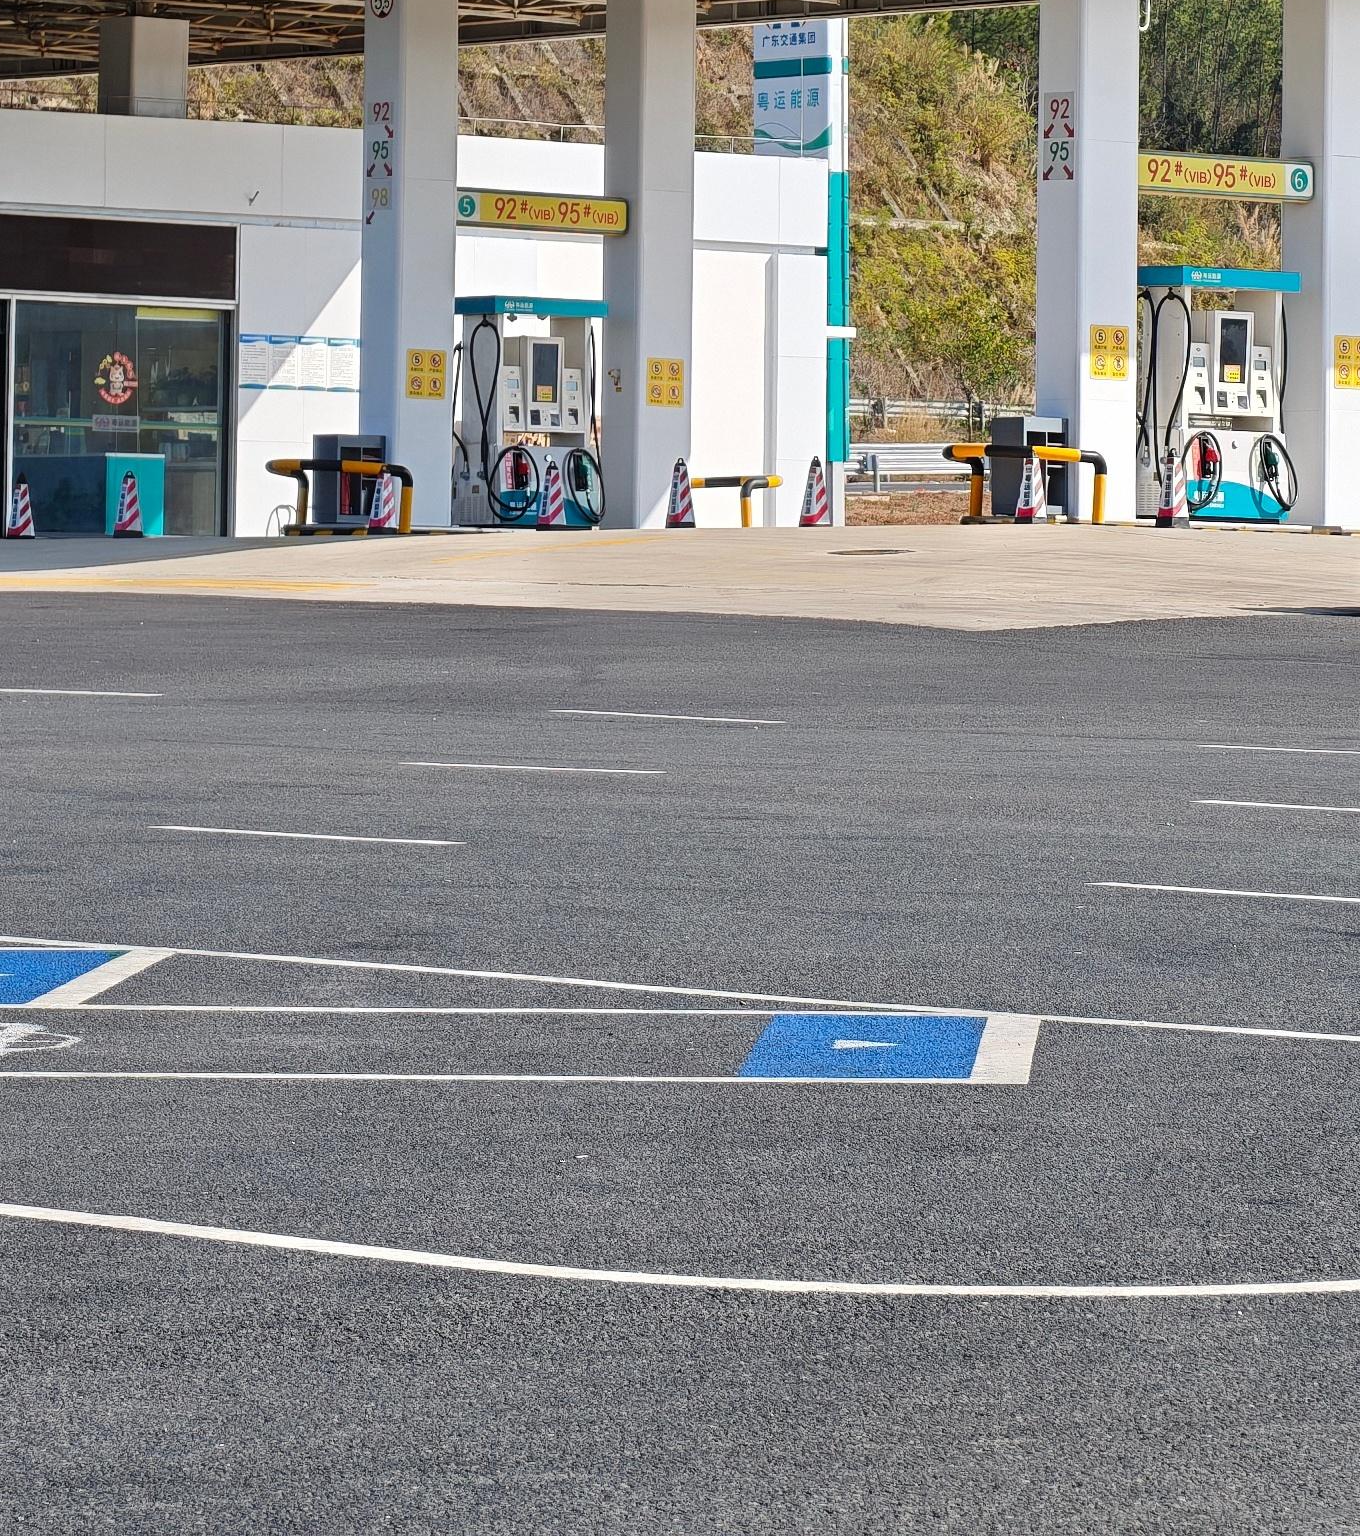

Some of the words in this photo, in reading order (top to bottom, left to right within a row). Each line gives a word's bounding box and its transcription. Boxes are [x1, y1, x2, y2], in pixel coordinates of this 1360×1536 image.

[762, 31, 816, 47] 广东交通集团
[757, 88, 820, 111] 粤运能源
[1050, 98, 1070, 120] 92
[373, 101, 390, 122] 92
[372, 140, 389, 160] 95
[1049, 140, 1069, 162] 95
[1293, 170, 1304, 190] 6
[371, 188, 388, 208] 98
[462, 198, 471, 215] 5
